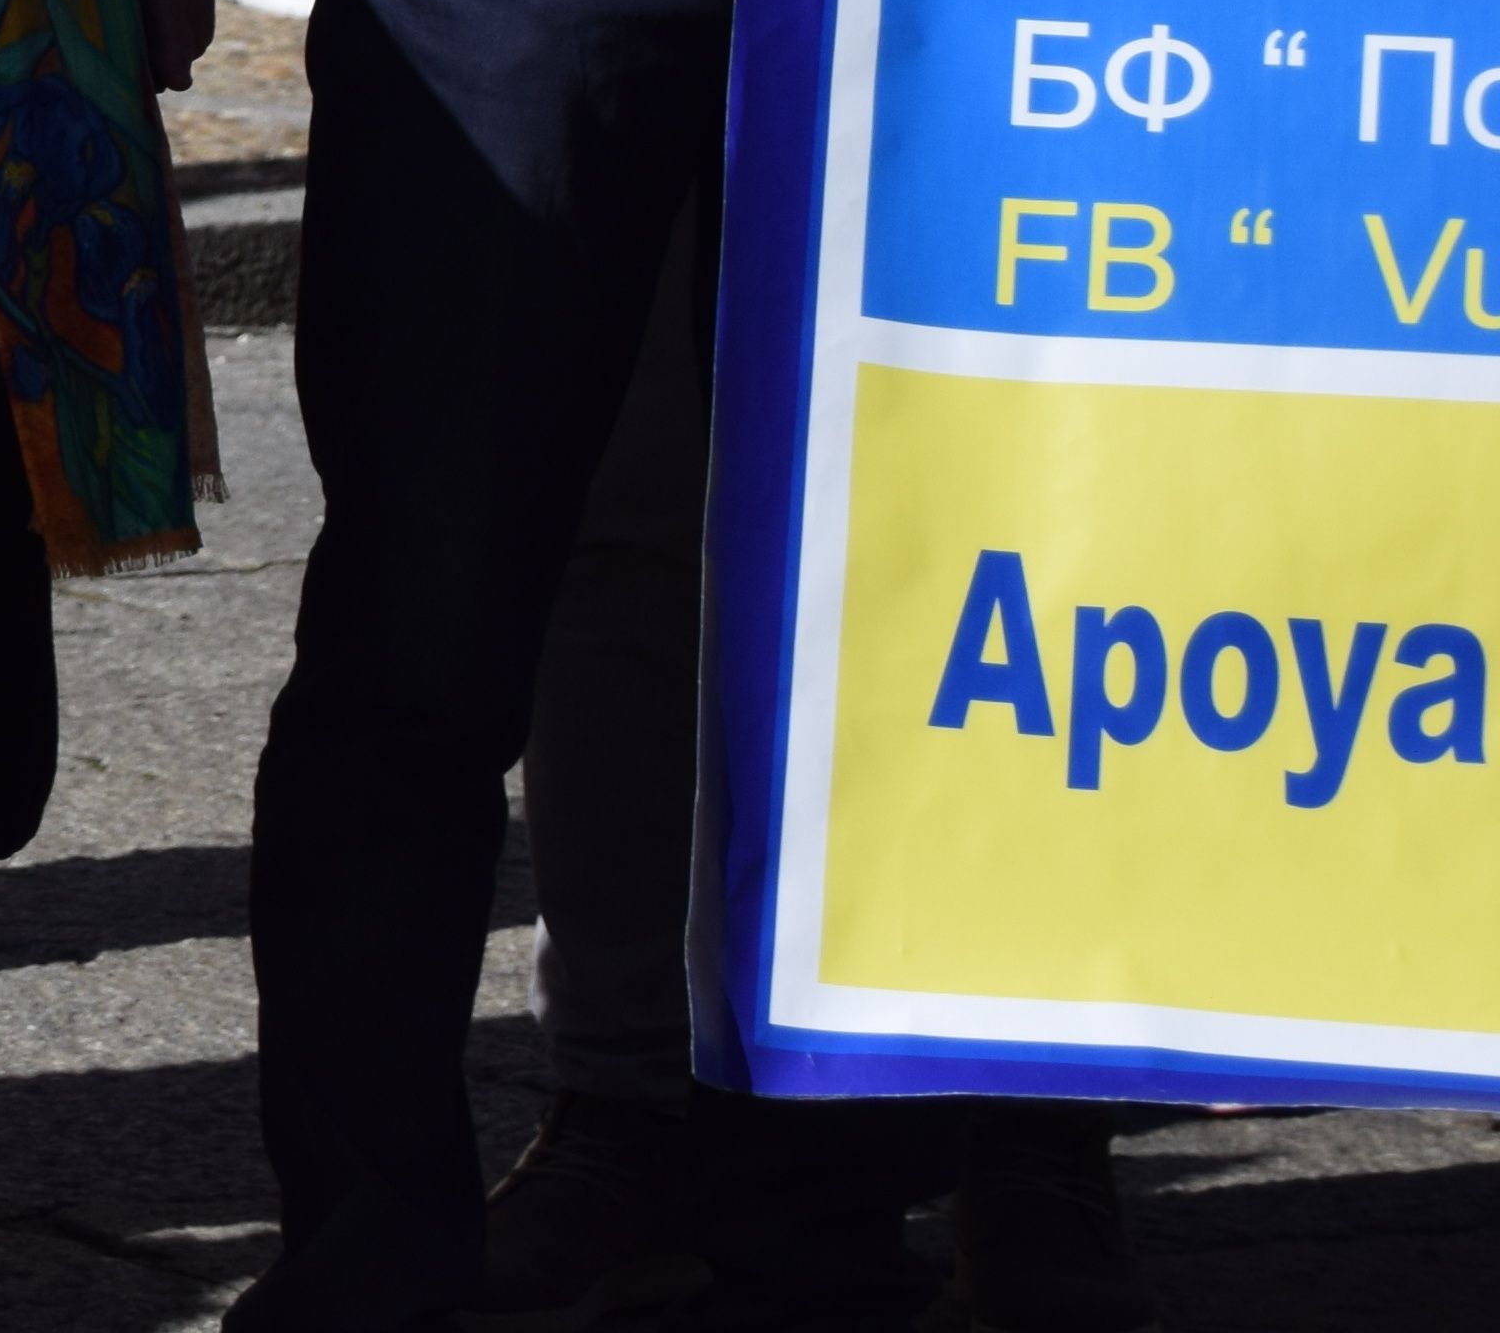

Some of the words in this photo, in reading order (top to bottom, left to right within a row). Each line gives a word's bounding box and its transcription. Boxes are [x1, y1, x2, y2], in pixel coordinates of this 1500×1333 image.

[1010, 17, 1213, 134] БФ
[996, 197, 1176, 312] FB
[928, 549, 1487, 810] Apoya
